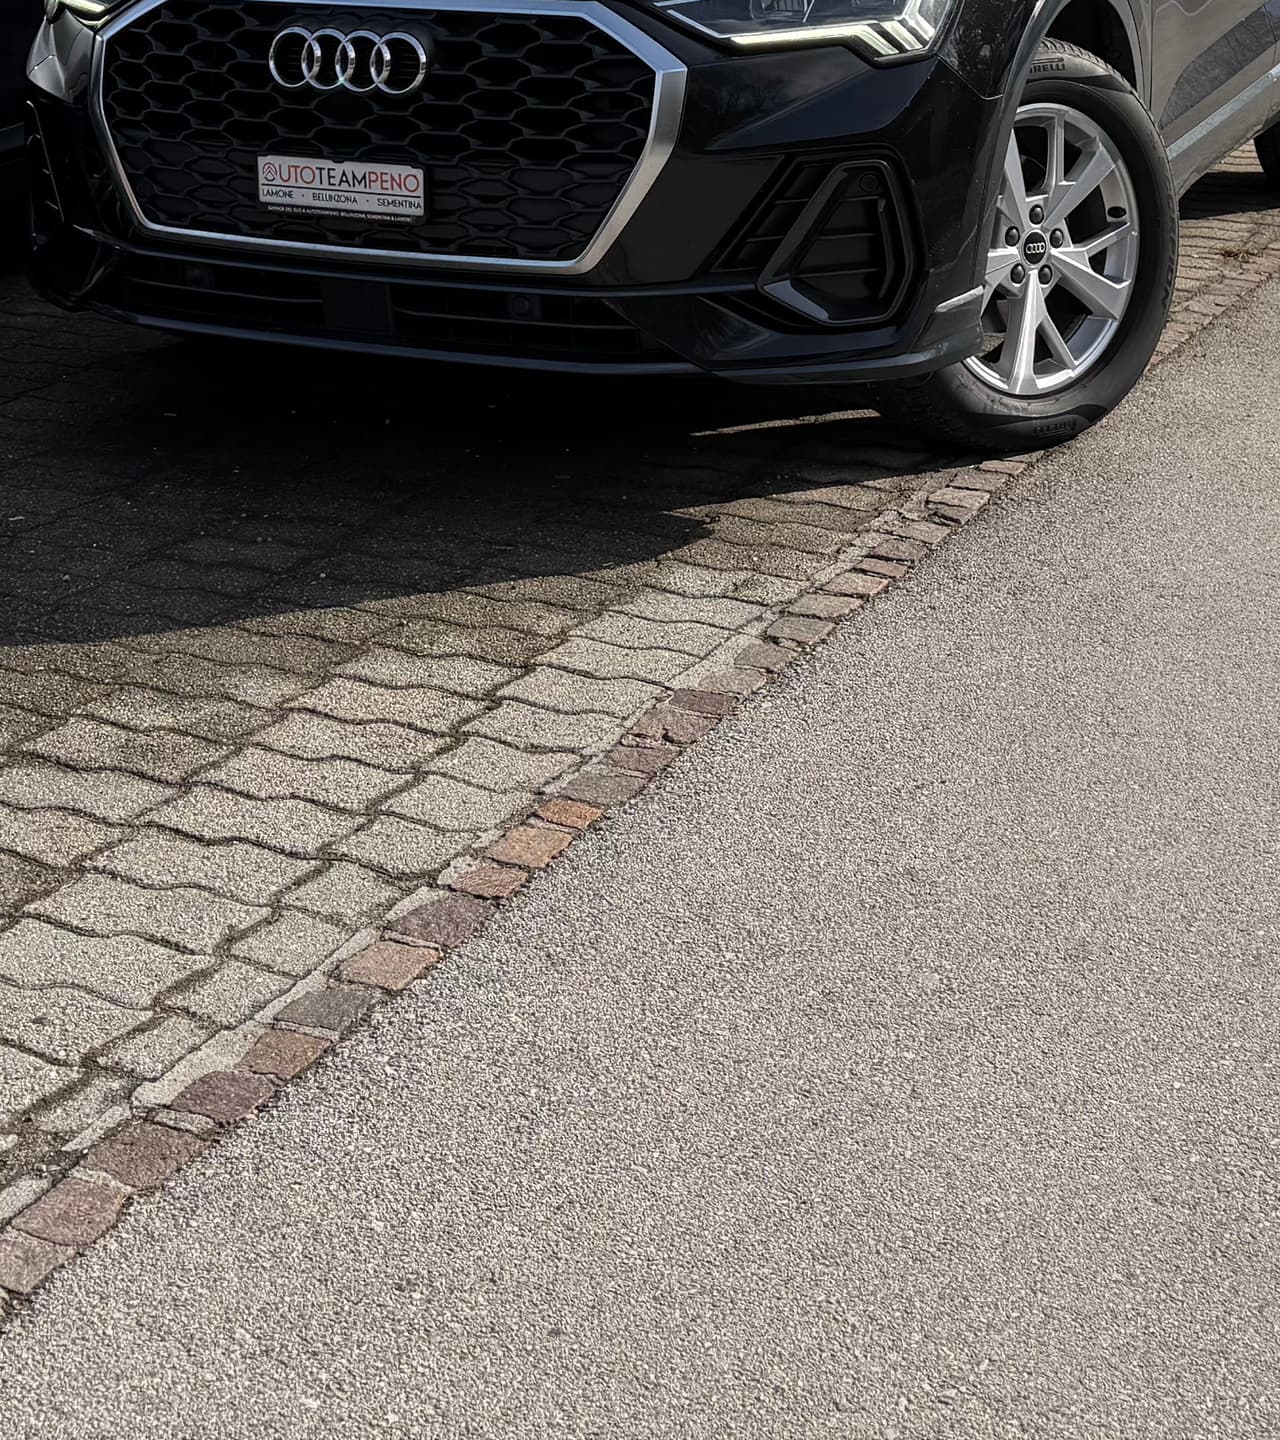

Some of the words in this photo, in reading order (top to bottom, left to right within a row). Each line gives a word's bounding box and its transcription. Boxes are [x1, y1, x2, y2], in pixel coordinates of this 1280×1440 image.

[1029, 63, 1066, 74] IRELLI
[261, 187, 295, 199] LAMONE
[312, 192, 358, 204] BELLINZONA
[377, 197, 422, 210] SEMENTINA
